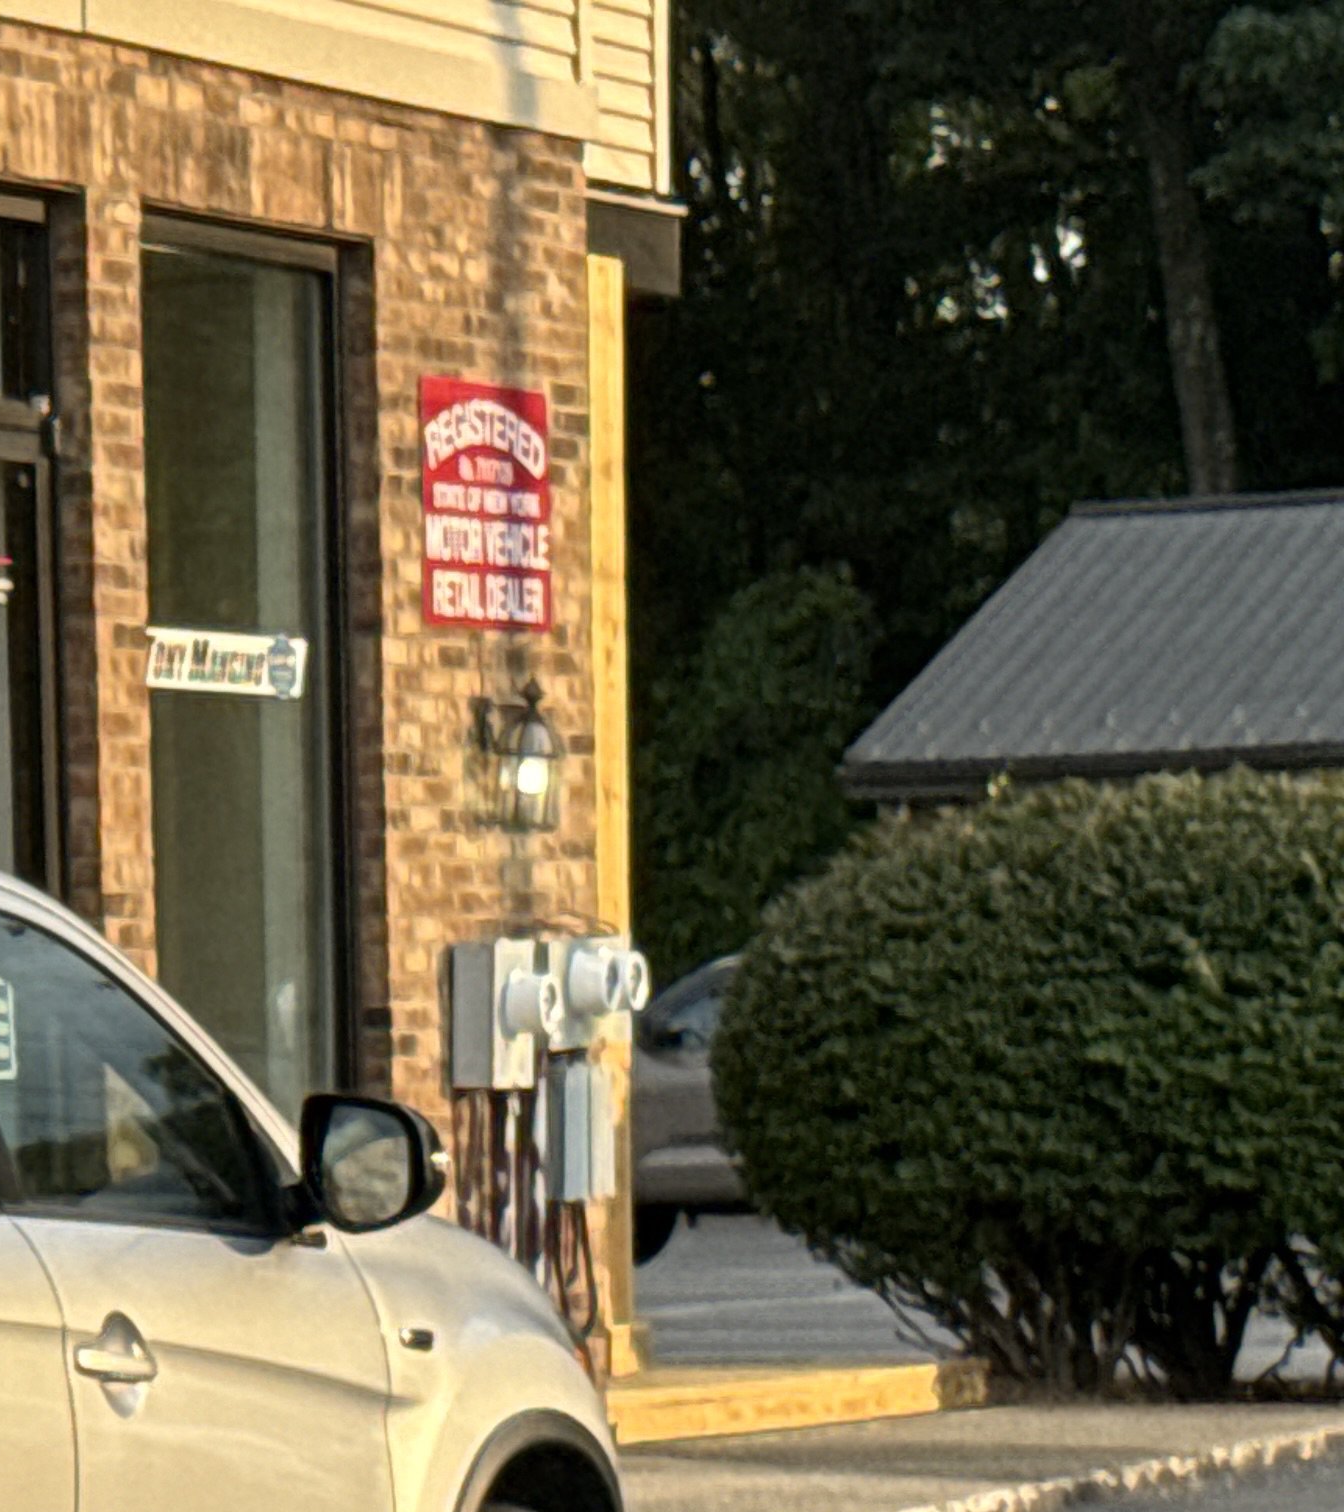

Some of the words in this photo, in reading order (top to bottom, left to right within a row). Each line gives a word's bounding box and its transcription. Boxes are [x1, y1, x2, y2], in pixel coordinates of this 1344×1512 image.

[424, 398, 546, 481] REGISTERED
[425, 513, 484, 565] MOTOR
[484, 518, 551, 571] VEHICLE
[432, 567, 485, 621] RETAIL
[485, 572, 545, 625] DEALER
[153, 641, 187, 681] ONY
